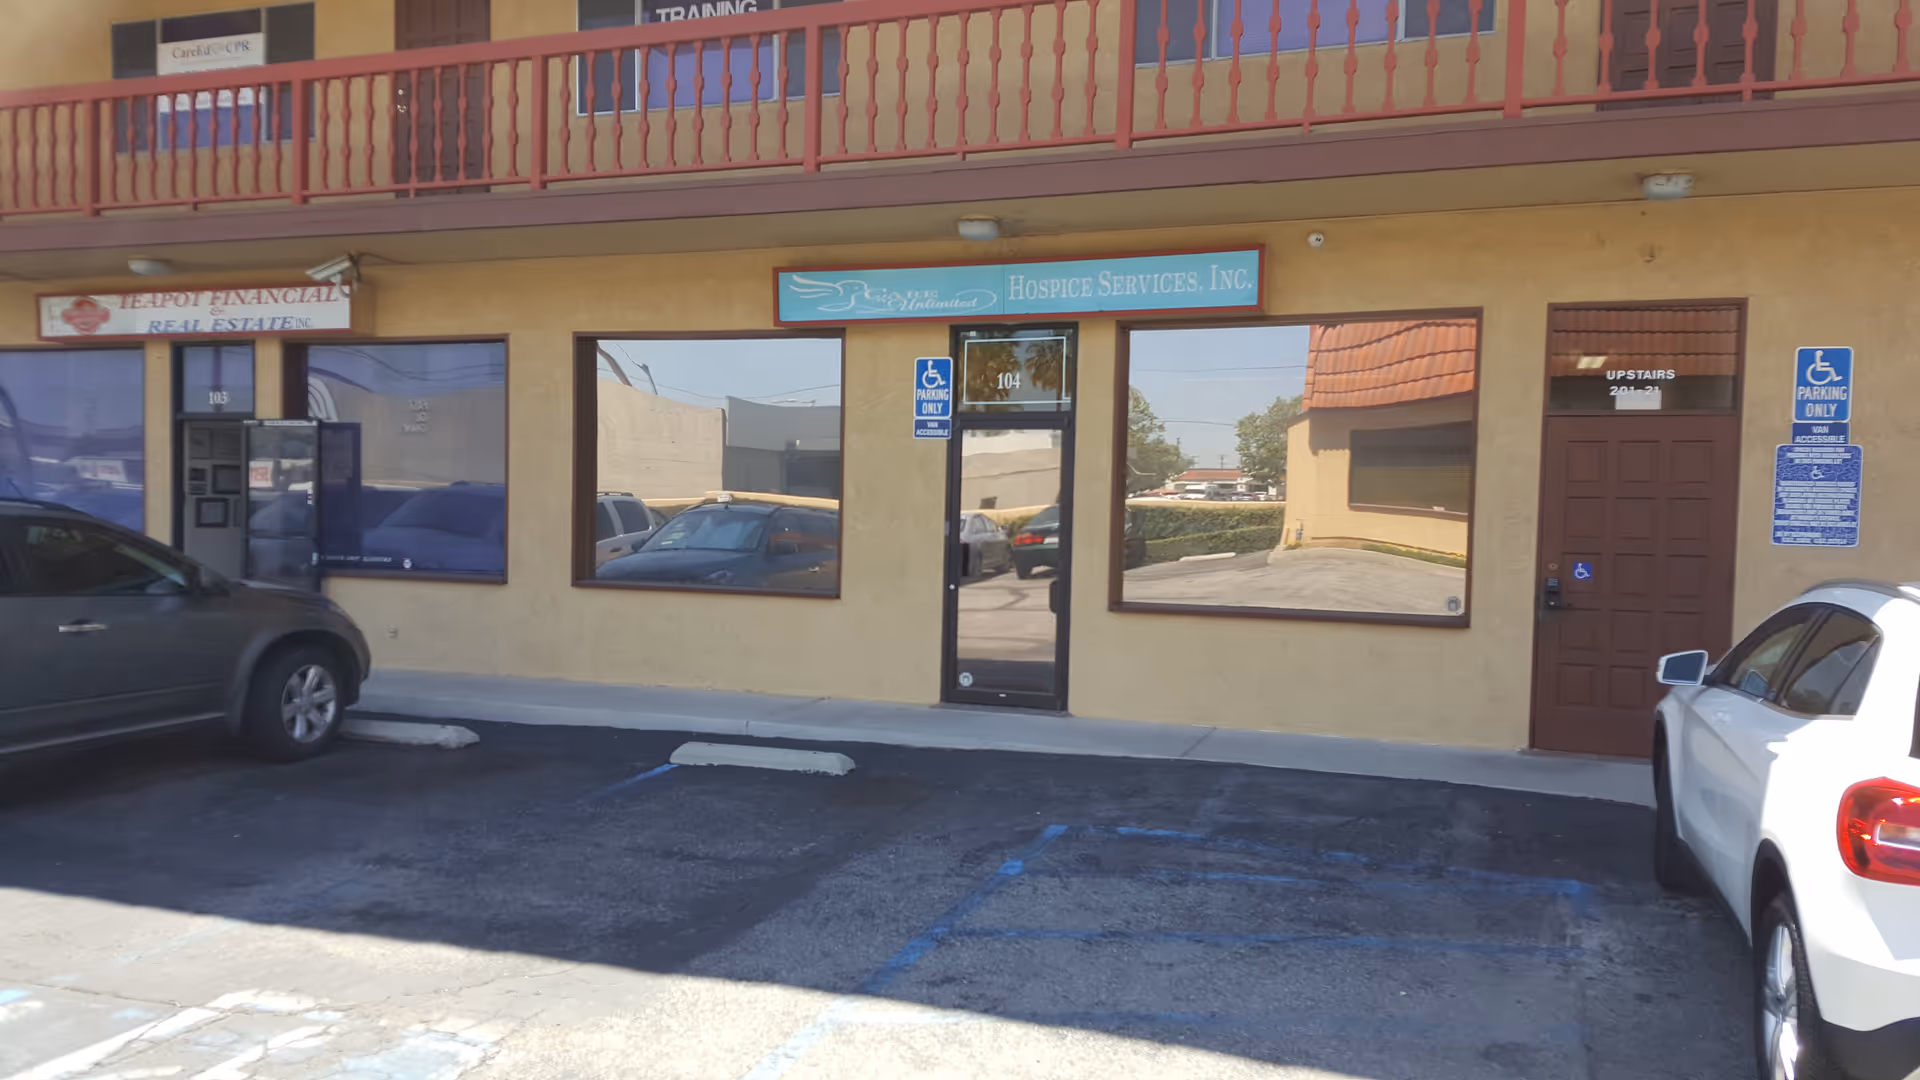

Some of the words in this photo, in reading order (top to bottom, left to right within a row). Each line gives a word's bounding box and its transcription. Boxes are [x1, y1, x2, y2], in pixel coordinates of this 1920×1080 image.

[656, 0, 757, 22] TRAINING
[1008, 275, 1094, 300] HOSPICE
[1209, 264, 1253, 291] INC.
[118, 291, 202, 310] TEAPOT
[208, 286, 340, 307] FINANCIAL
[209, 305, 226, 317] &
[146, 318, 205, 334] REAL
[211, 315, 295, 333] ESTATE
[996, 372, 1021, 389] 104
[1606, 369, 1676, 380] UPSTAIRS
[916, 388, 949, 401] PARKING
[1796, 386, 1848, 401] PARKING
[922, 402, 943, 415] ONLY
[1805, 402, 1838, 418] ONLY
[1811, 425, 1829, 434] VAN
[1794, 435, 1846, 443] ACCESSIBLE
